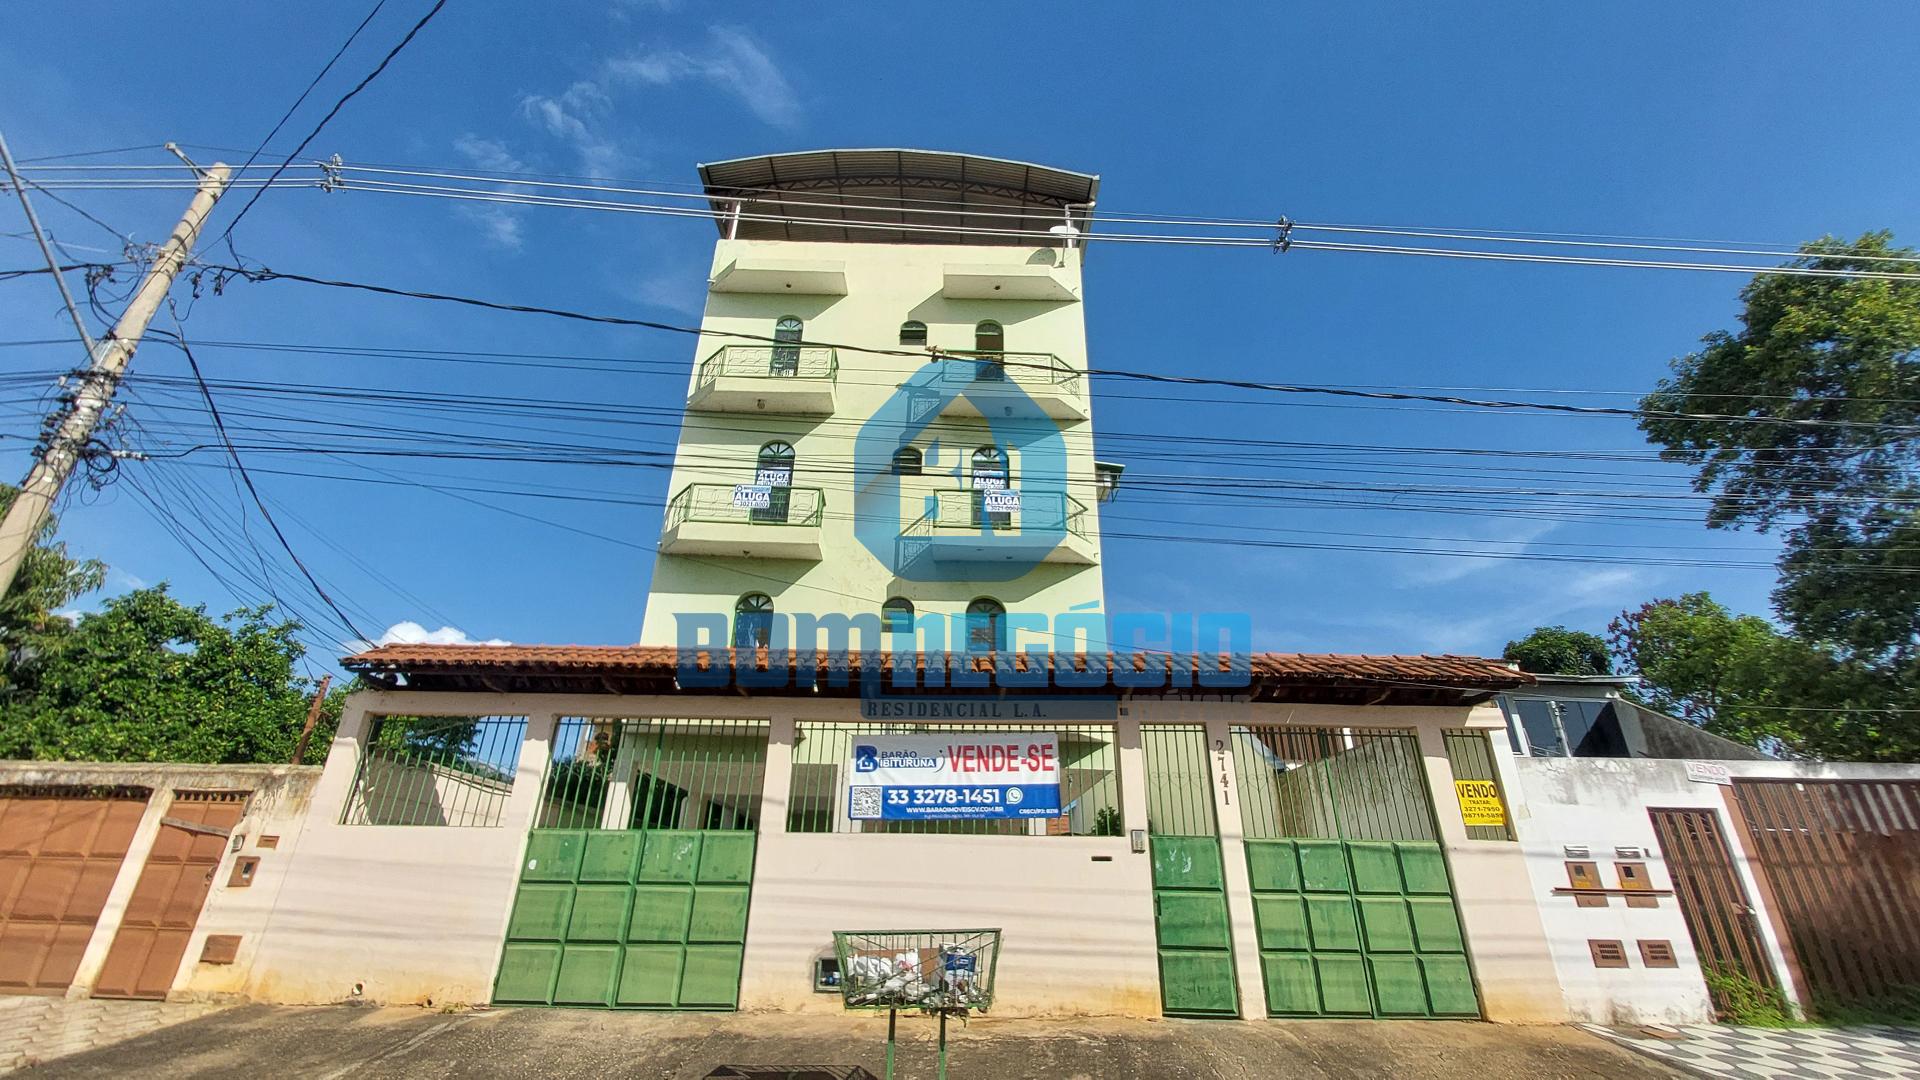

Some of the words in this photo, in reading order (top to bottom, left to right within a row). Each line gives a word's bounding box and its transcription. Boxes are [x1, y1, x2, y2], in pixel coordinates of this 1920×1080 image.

[757, 473, 789, 482] ALUGA
[973, 477, 1006, 485] ALUGA
[734, 492, 770, 501] ALUGA
[984, 496, 1019, 505] ALUGA
[866, 701, 1002, 718] RESIDENCIAL
[1013, 702, 1048, 718] L.A.
[880, 749, 918, 759] BARÃO
[947, 744, 1054, 773] VENDE-SE
[879, 759, 935, 768] IBITURUNA
[1215, 739, 1230, 806] 2741
[1687, 763, 1726, 776] VENDO
[887, 789, 909, 804] 33
[913, 788, 1000, 804] 3278-1451
[1456, 783, 1498, 798] VENDO
